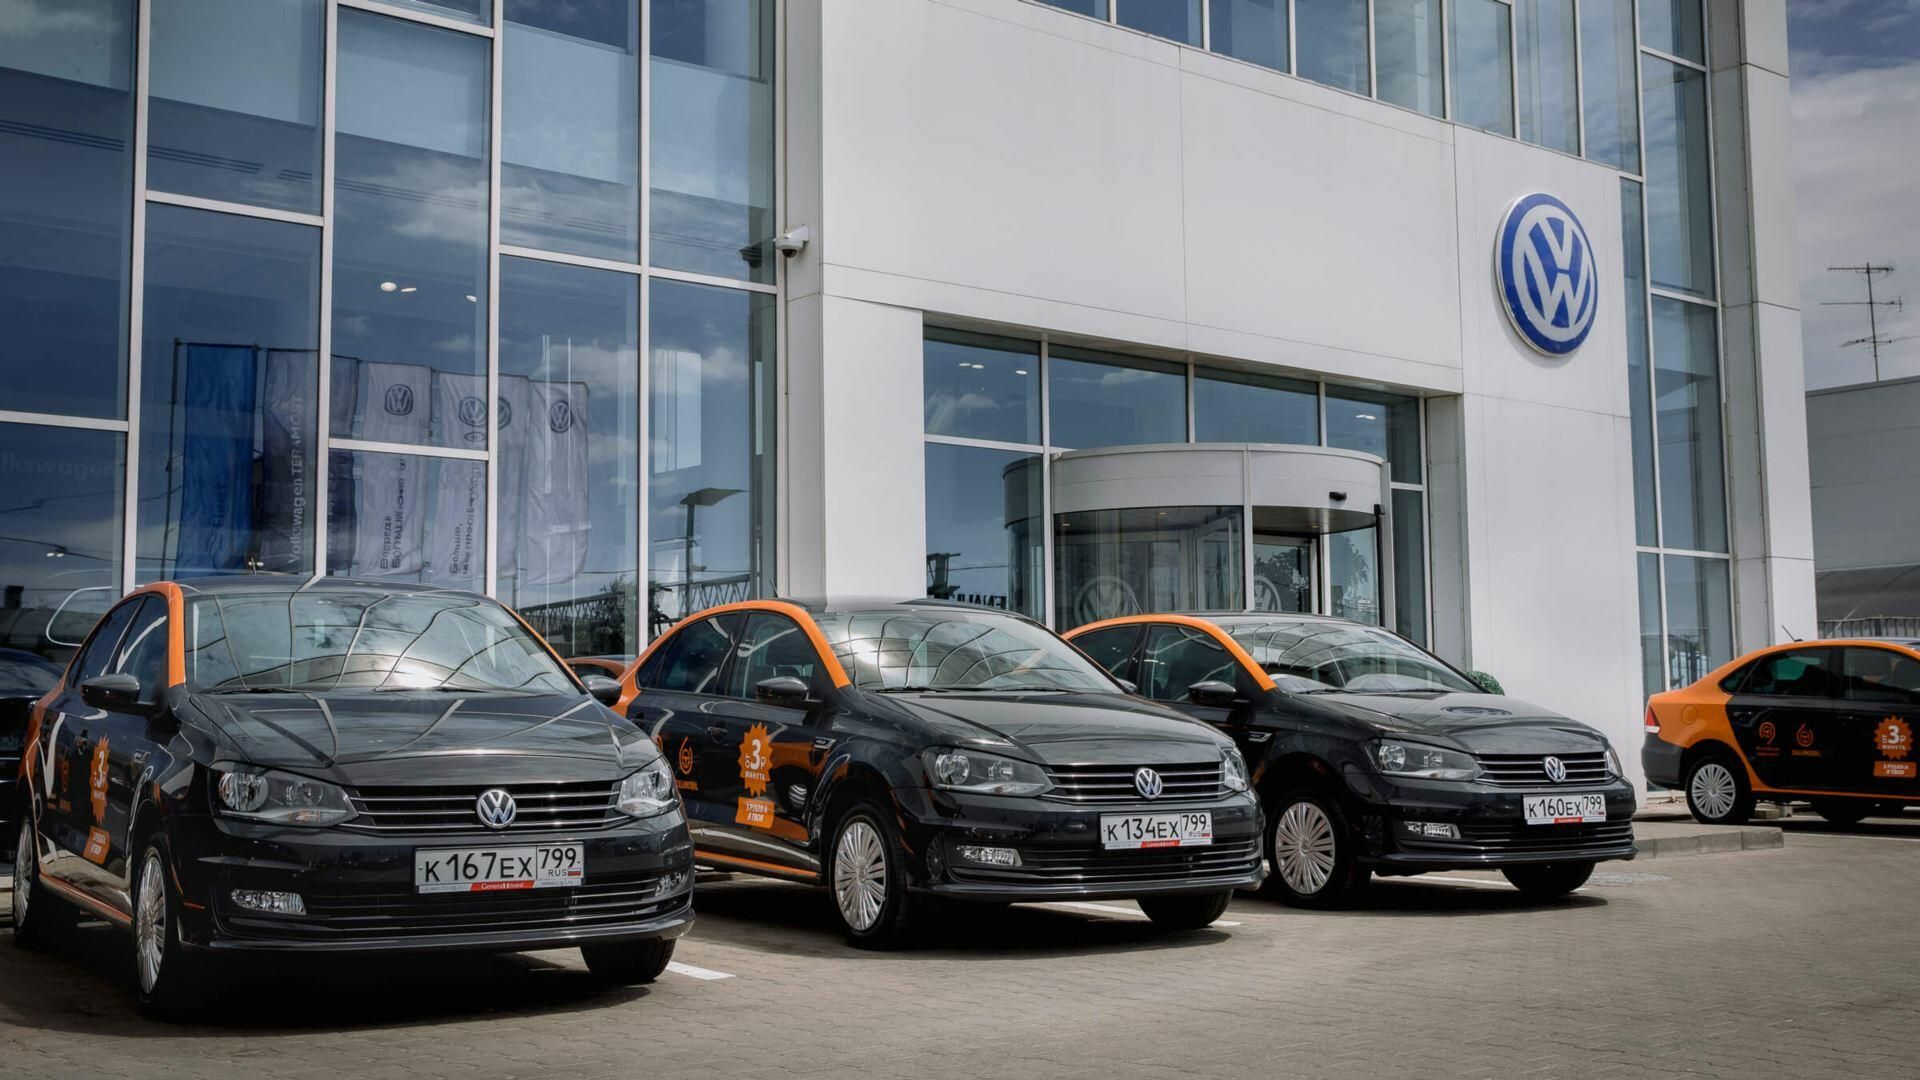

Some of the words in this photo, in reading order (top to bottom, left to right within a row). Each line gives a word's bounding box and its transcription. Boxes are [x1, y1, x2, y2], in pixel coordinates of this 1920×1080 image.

[1888, 725, 1900, 744] 3
[750, 738, 761, 770] 3
[477, 790, 516, 828] VW
[1583, 795, 1602, 810] 799
[1182, 814, 1207, 831] 799
[538, 847, 577, 869] 799
[548, 869, 567, 877] RUS
